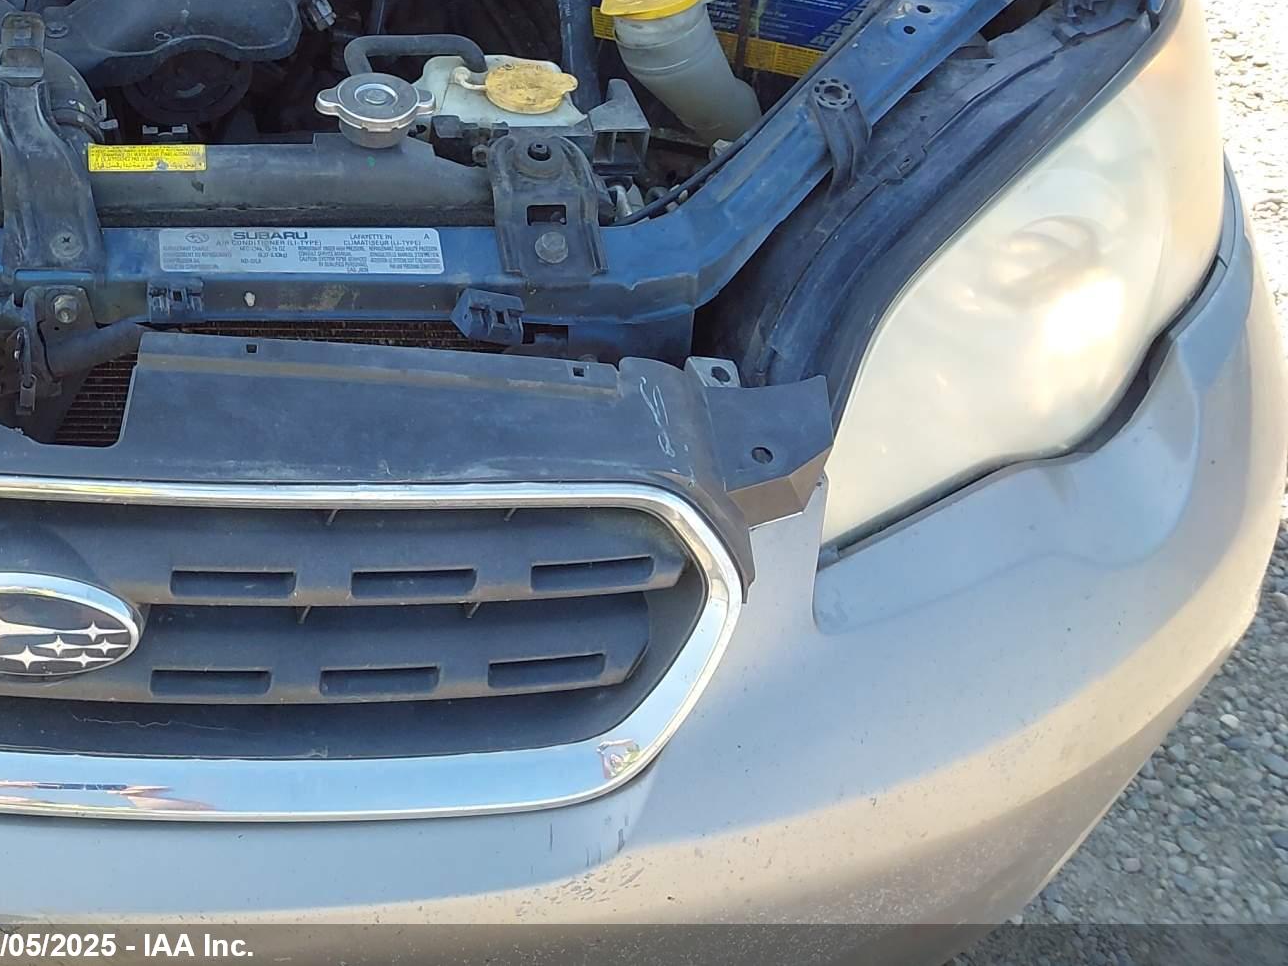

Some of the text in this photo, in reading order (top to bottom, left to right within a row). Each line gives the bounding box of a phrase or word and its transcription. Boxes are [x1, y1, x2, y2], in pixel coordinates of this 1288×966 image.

[233, 231, 308, 240] SUBARU
[423, 233, 431, 241] A
[232, 239, 285, 247] CONDITIONER
